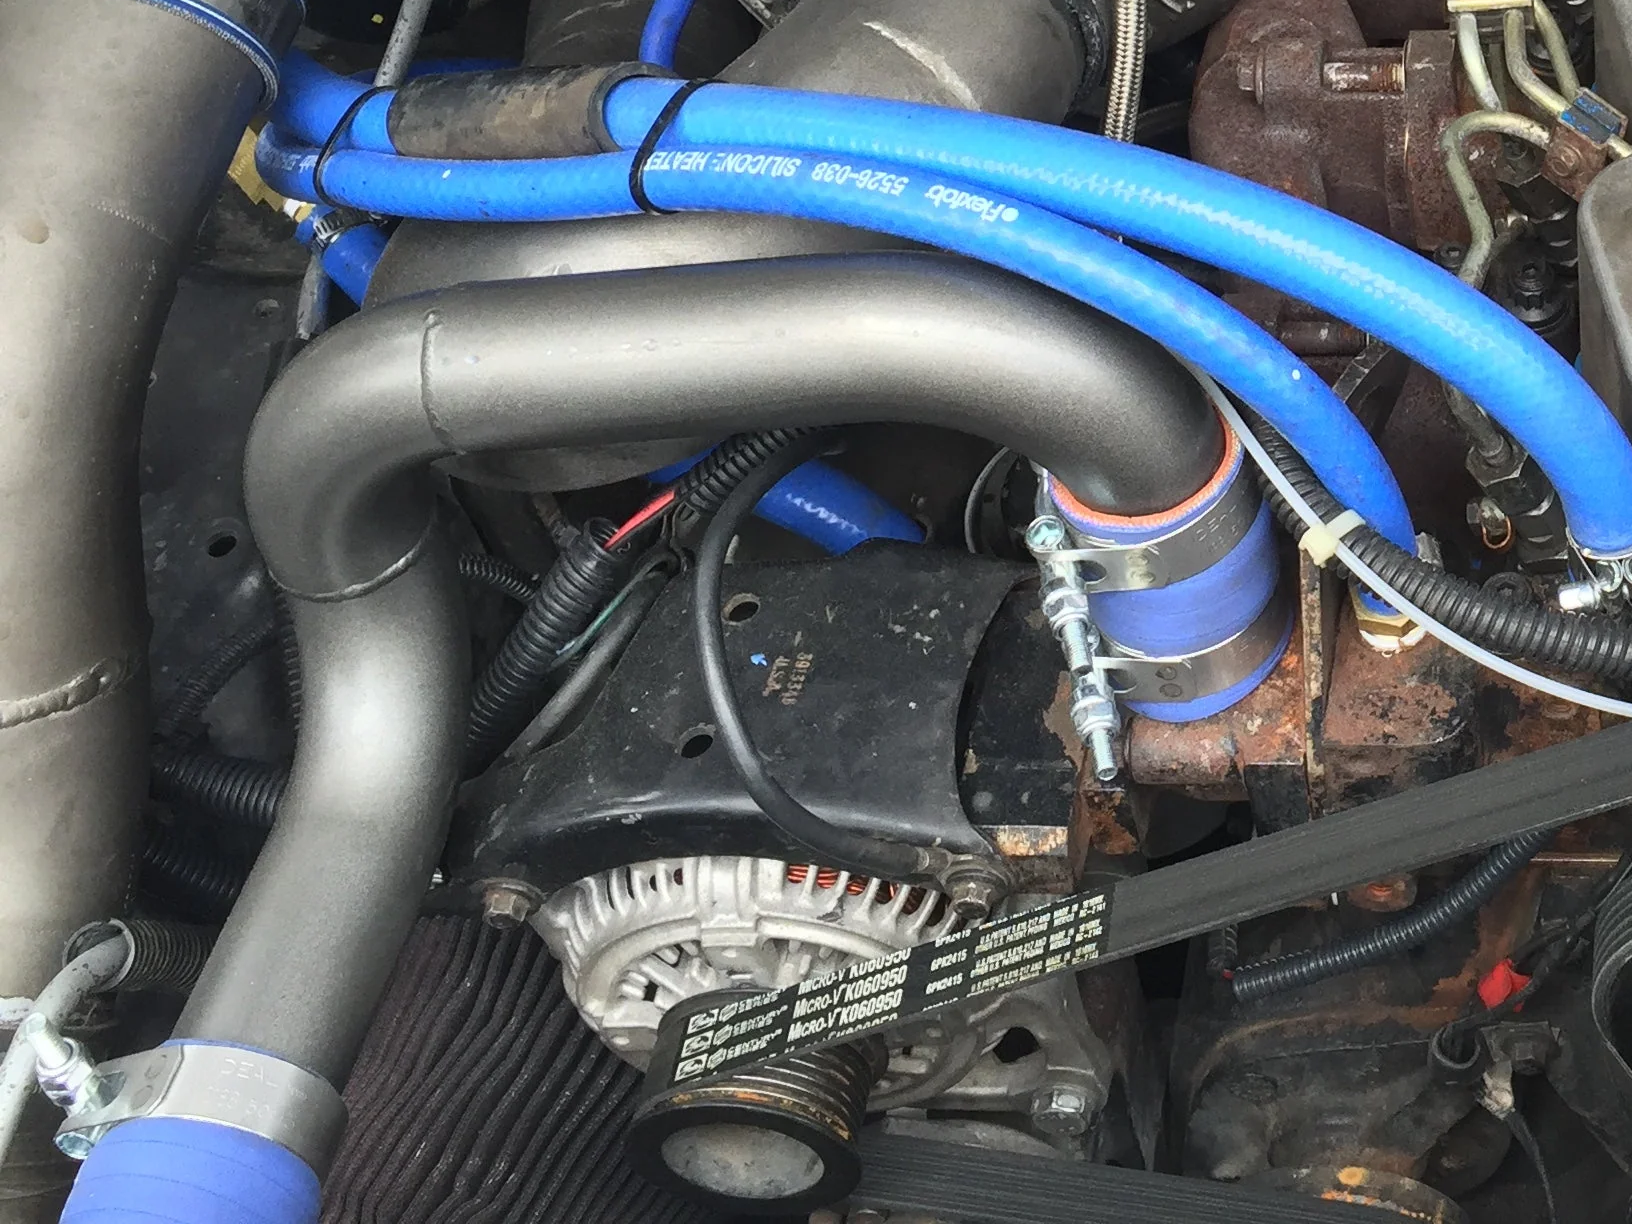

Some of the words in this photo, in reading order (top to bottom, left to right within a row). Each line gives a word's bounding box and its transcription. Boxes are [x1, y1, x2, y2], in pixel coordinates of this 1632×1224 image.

[810, 162, 911, 197] 5526-038
[843, 964, 909, 1003] K060950
[838, 988, 904, 1027] K060950
